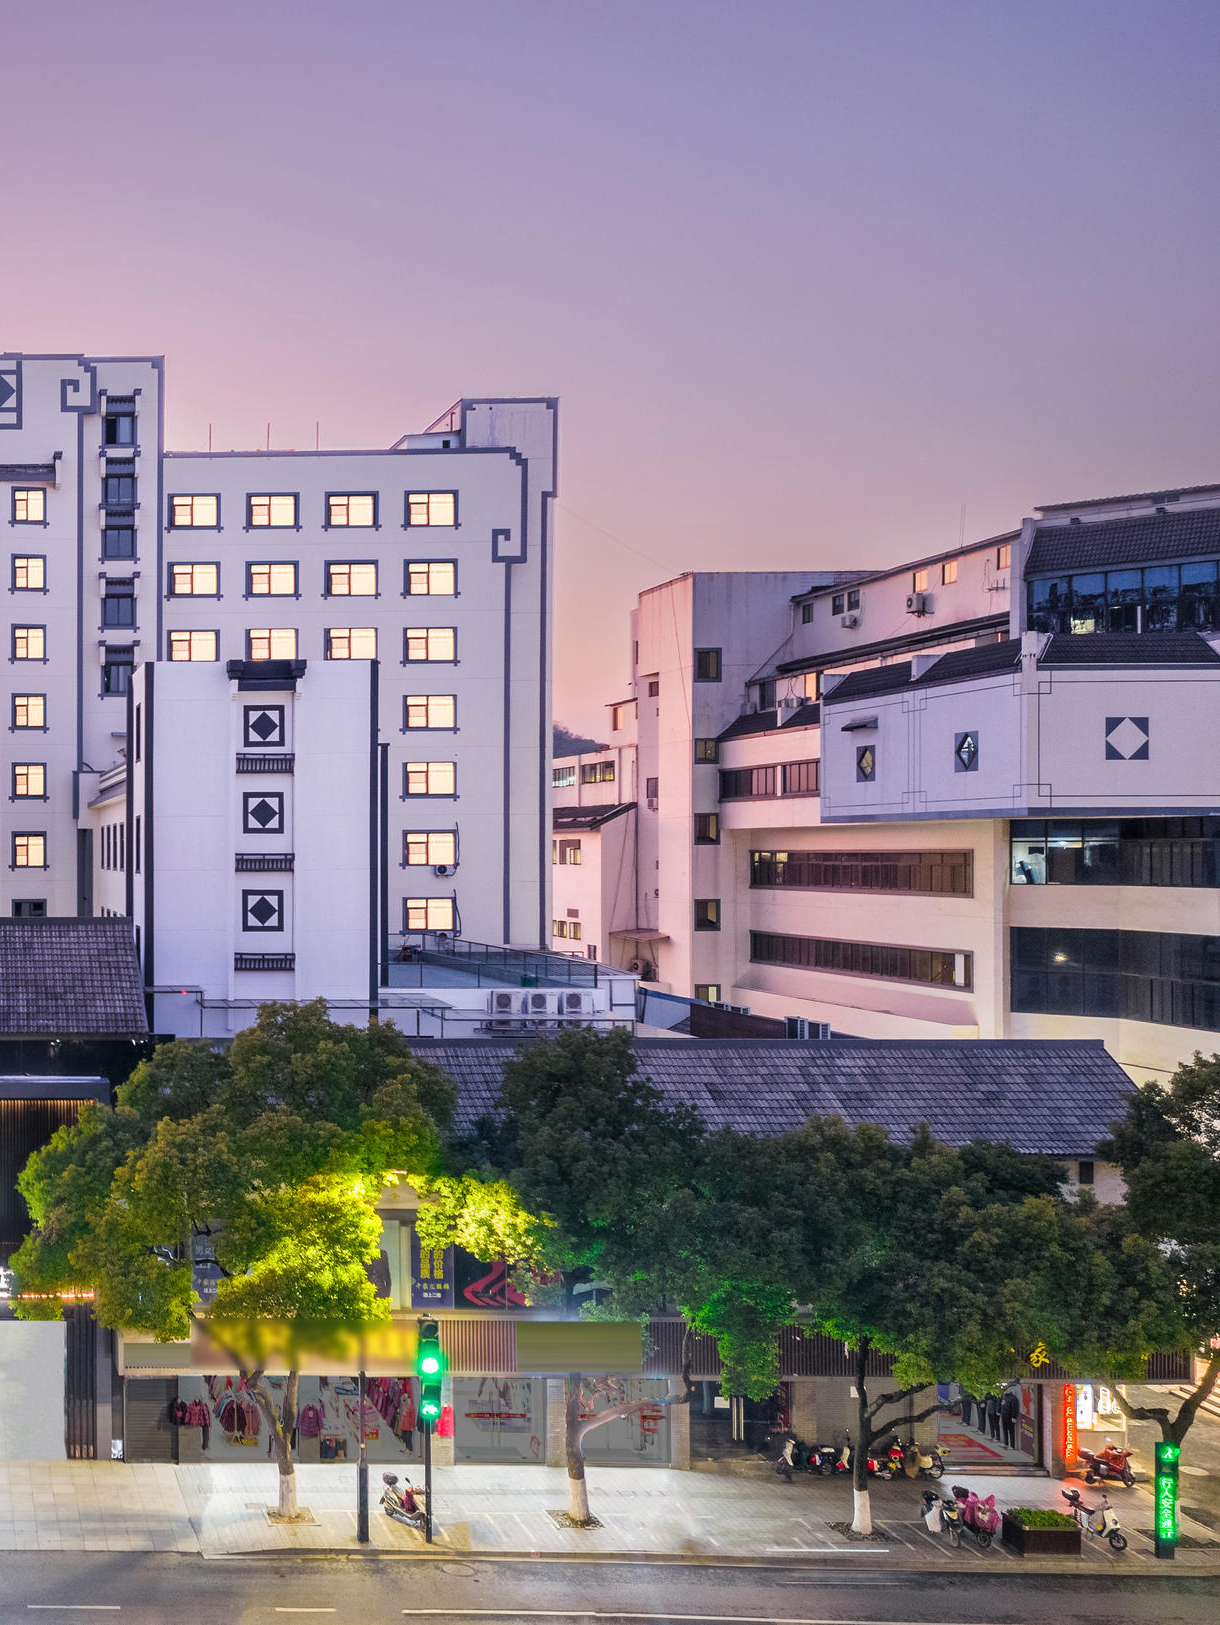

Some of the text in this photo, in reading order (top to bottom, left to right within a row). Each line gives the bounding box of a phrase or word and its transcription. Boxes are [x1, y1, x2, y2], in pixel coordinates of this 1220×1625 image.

[1065, 1418, 1074, 1458] Welcome
[1161, 1477, 1174, 1539] 行人安全通行
